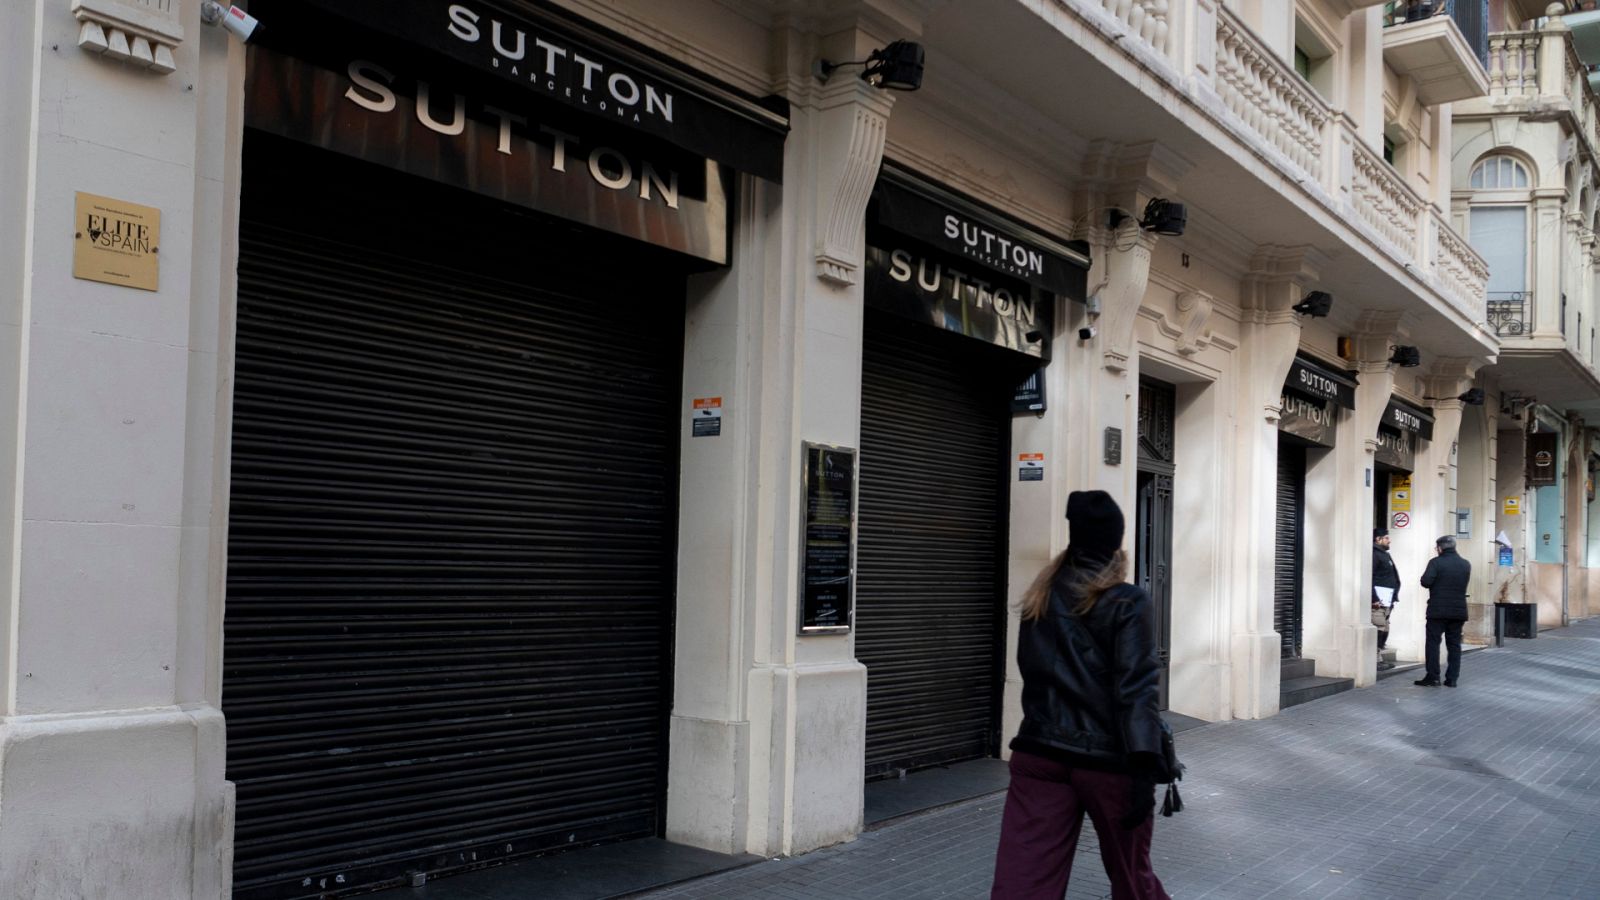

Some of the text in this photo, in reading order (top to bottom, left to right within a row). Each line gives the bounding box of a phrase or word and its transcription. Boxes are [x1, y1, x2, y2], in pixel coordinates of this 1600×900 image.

[447, 4, 674, 123] SUTTON
[492, 57, 641, 122] BARCELONA
[344, 59, 680, 210] SUTTON
[87, 213, 149, 241] ELITE
[101, 231, 149, 254] SPAIN
[943, 214, 1044, 275] SUTTON
[963, 246, 1030, 278] BARCELONA
[888, 250, 1036, 326] SUTTON
[1300, 369, 1337, 395] SUTTON
[1394, 409, 1420, 429] SUTTON
[815, 470, 845, 479] SUTTON
